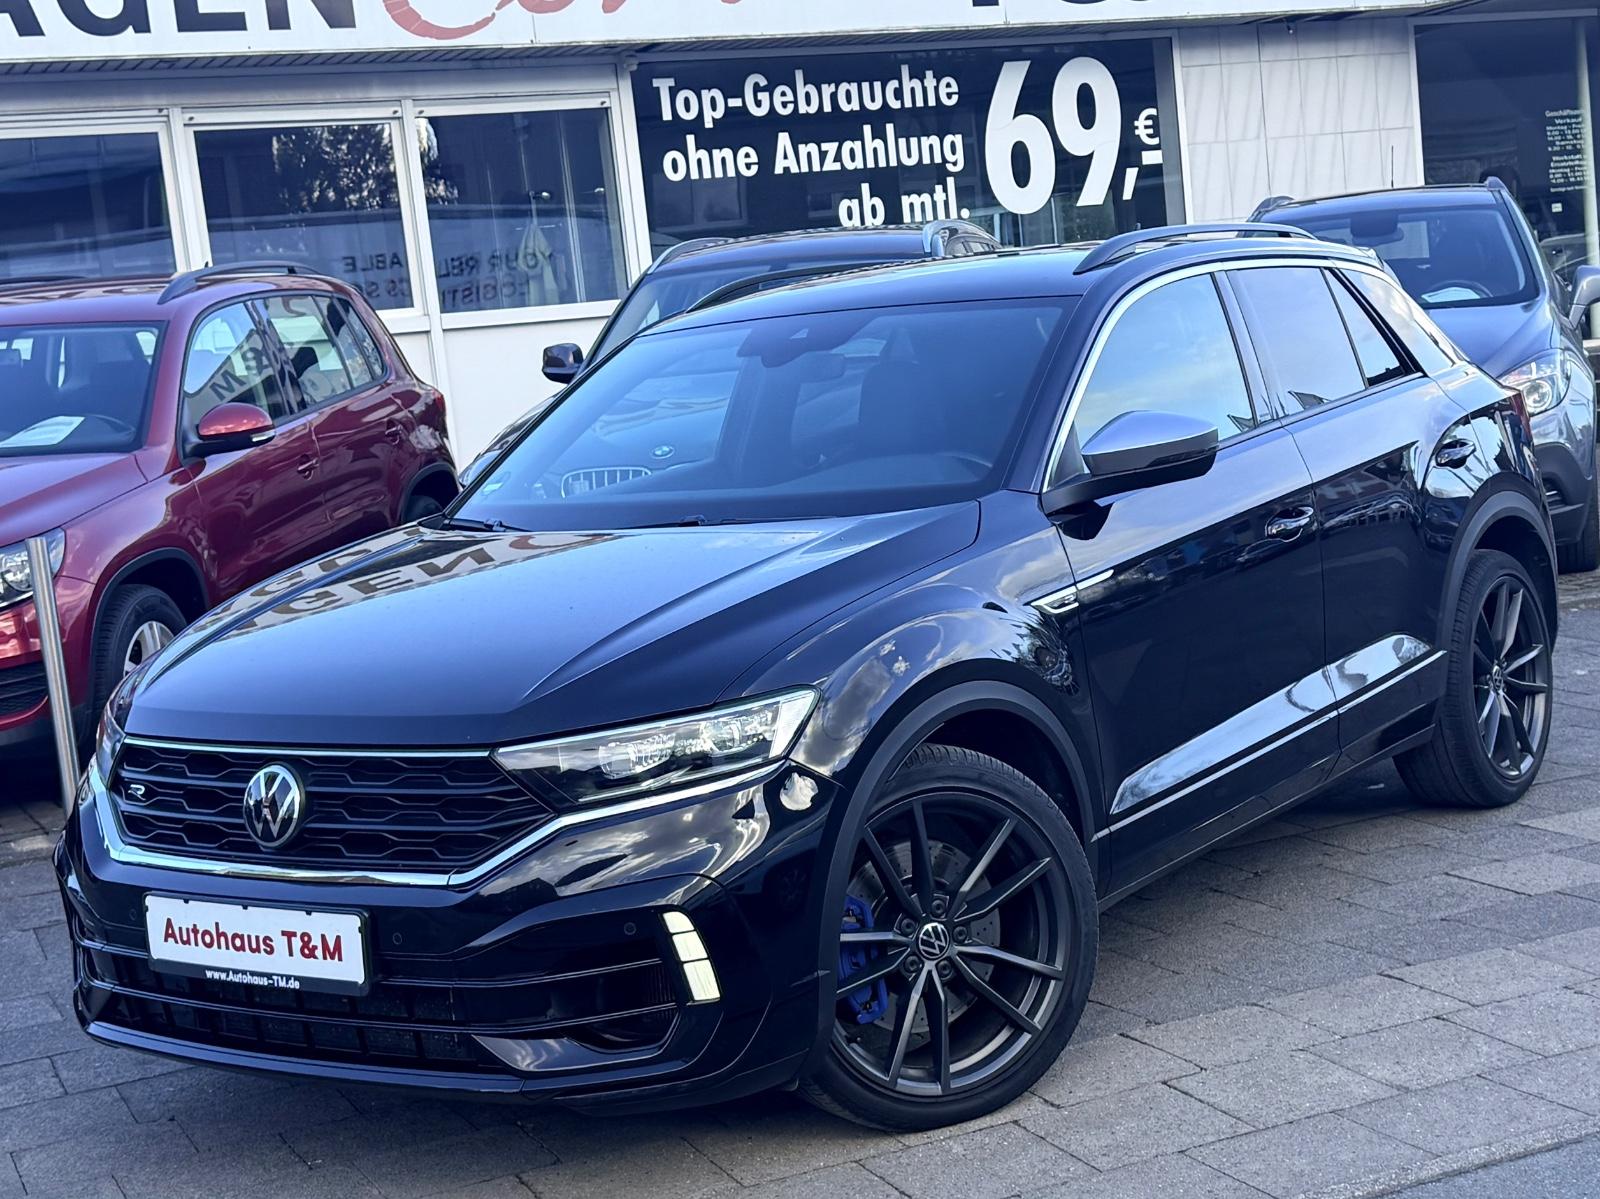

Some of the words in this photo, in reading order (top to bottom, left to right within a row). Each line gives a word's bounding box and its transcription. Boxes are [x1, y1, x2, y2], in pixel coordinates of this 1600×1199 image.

[652, 64, 959, 129] Top-Gebrauchte
[663, 134, 759, 182] ohne
[774, 123, 965, 173] Anzahlung
[838, 183, 885, 227] ab
[901, 176, 970, 224] mtl.
[164, 917, 275, 956] Autohaus
[281, 930, 343, 962] T&M
[205, 968, 300, 990] www.Autohaus-TM.de
